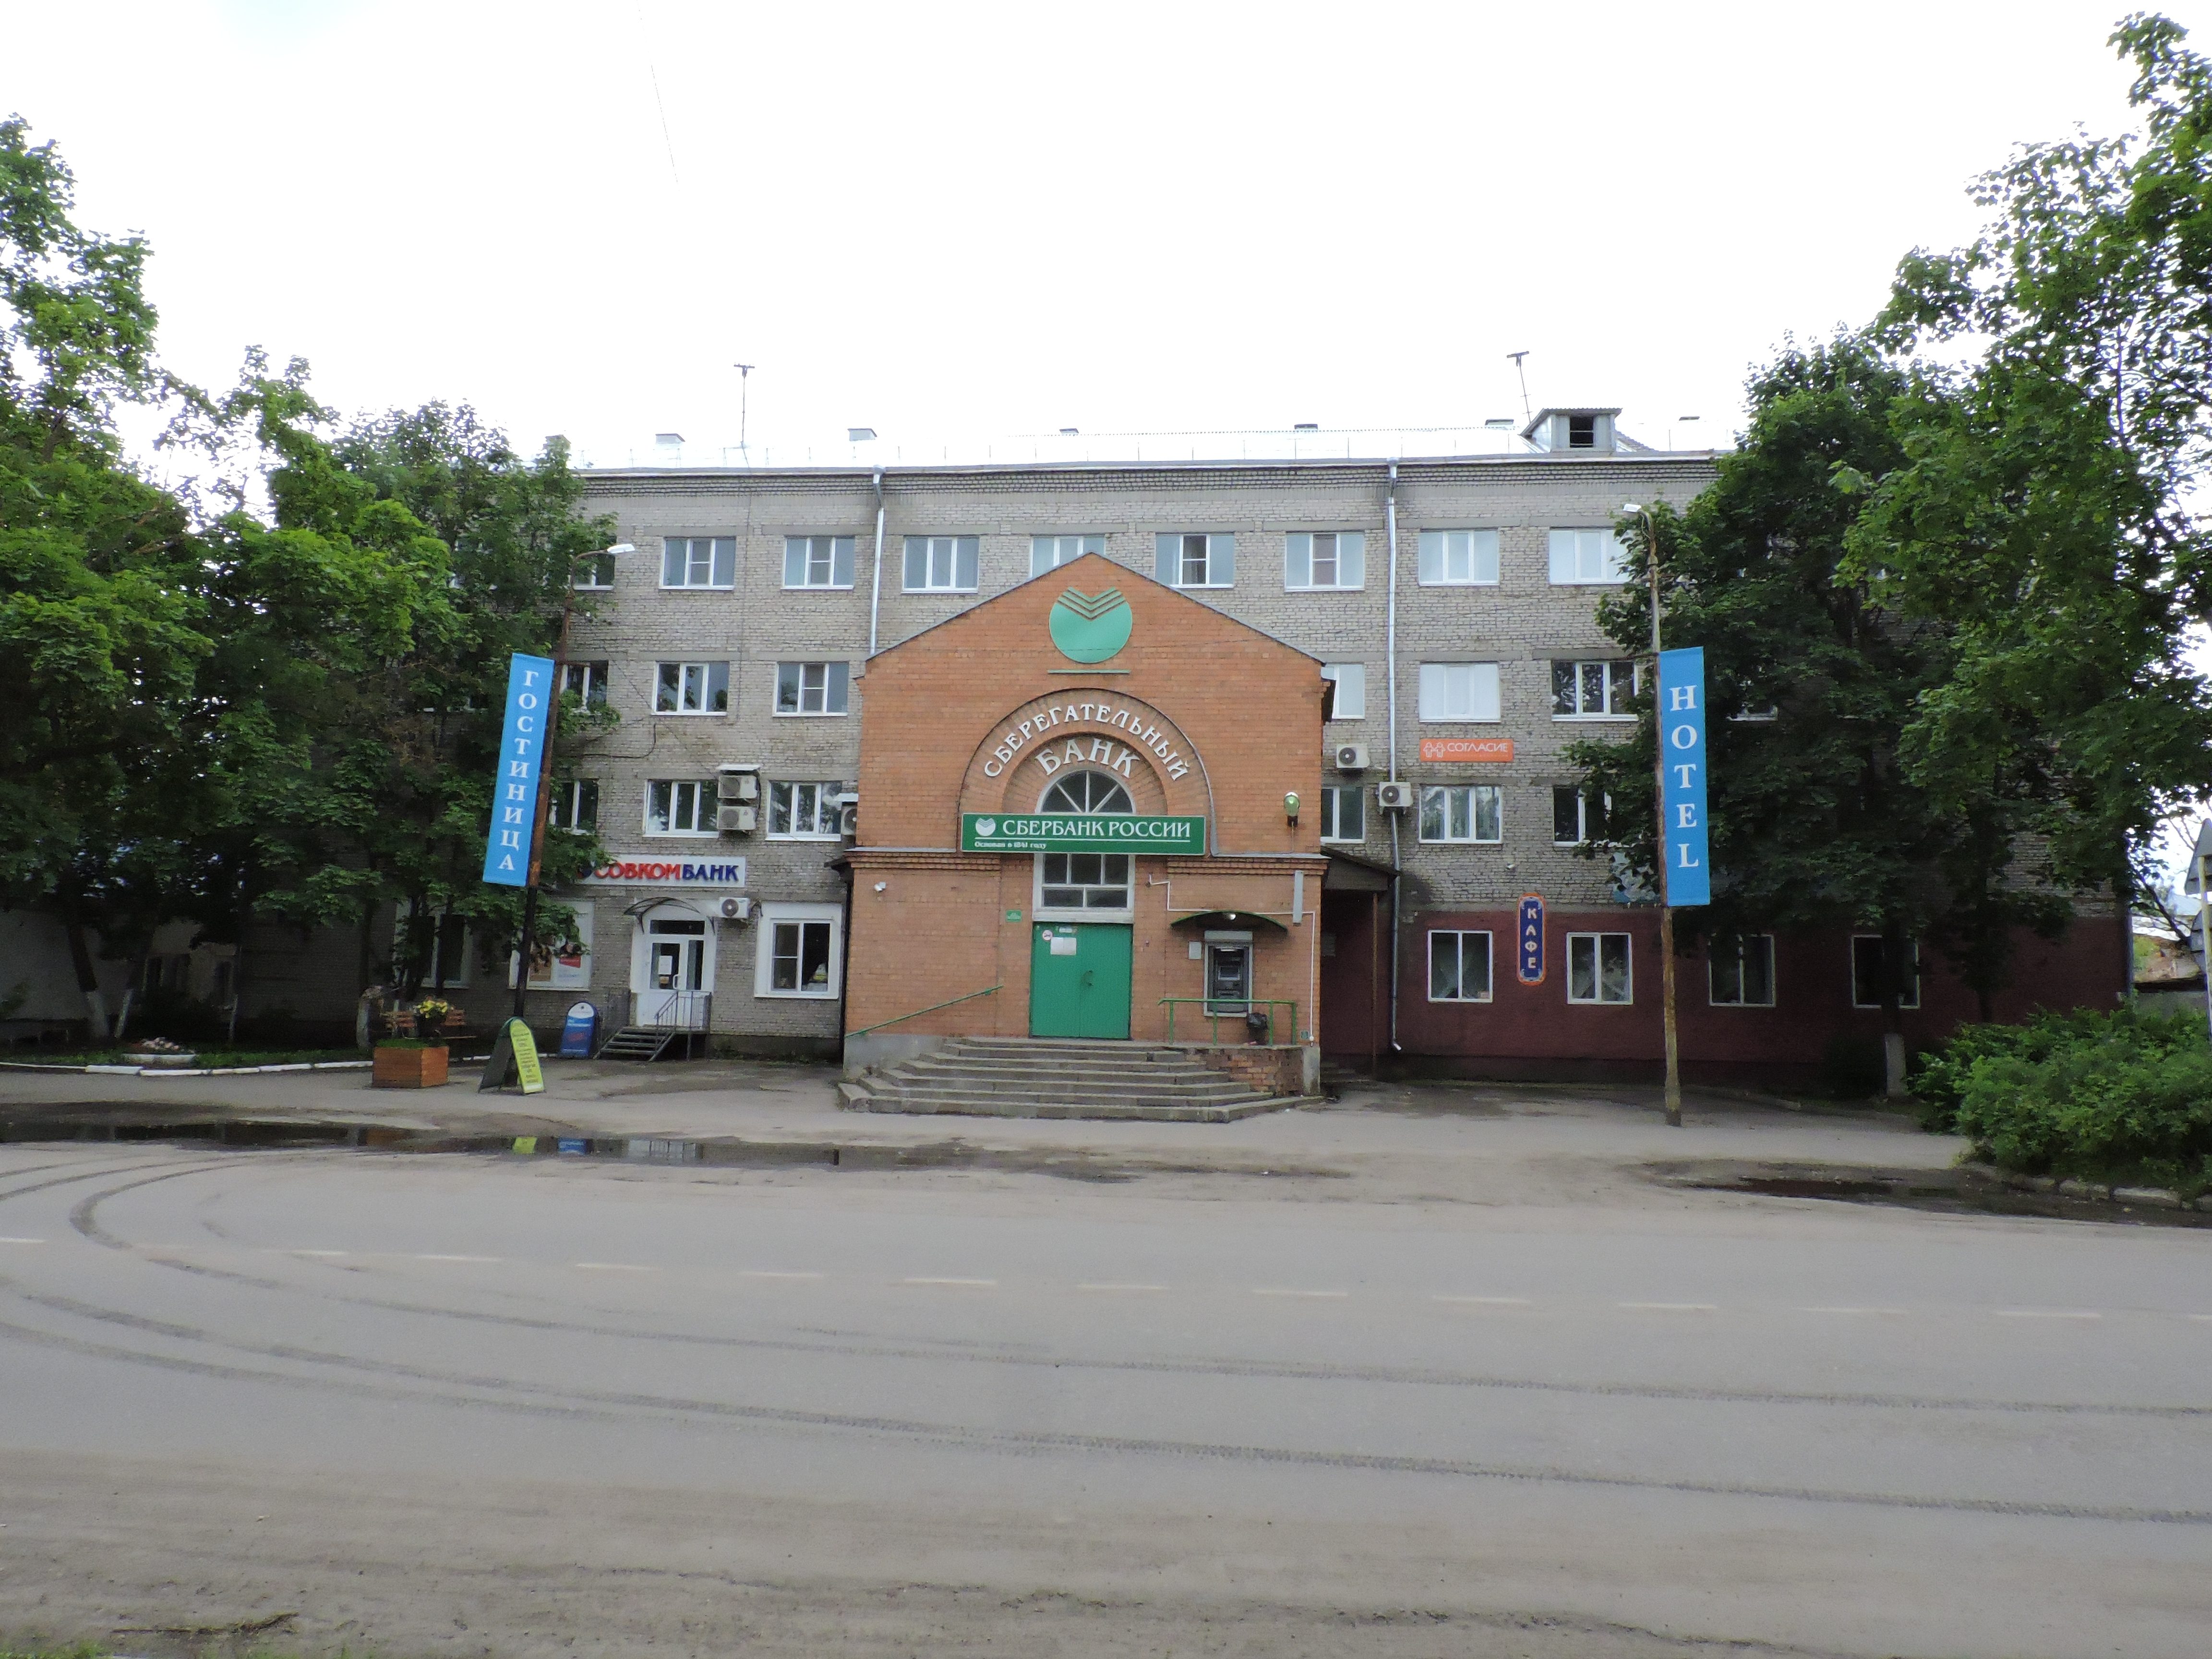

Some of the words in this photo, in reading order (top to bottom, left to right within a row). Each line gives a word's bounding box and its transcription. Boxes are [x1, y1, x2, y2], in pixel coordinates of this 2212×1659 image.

[984, 703, 1190, 781] СБЕРЕГАТЕЛЬНЫЙ
[1035, 738, 1140, 779] БАНК
[1447, 743, 1508, 752] СОГЛАСИЕ
[498, 670, 538, 871] ГОСТИНИЦА
[1669, 685, 1699, 868] HOTEL
[1003, 820, 1104, 836] СБЕРБАНК
[1109, 821, 1190, 837] РОССИИ
[594, 862, 738, 881] СОВКОМБАНК
[1525, 908, 1538, 969] КАФЕ
